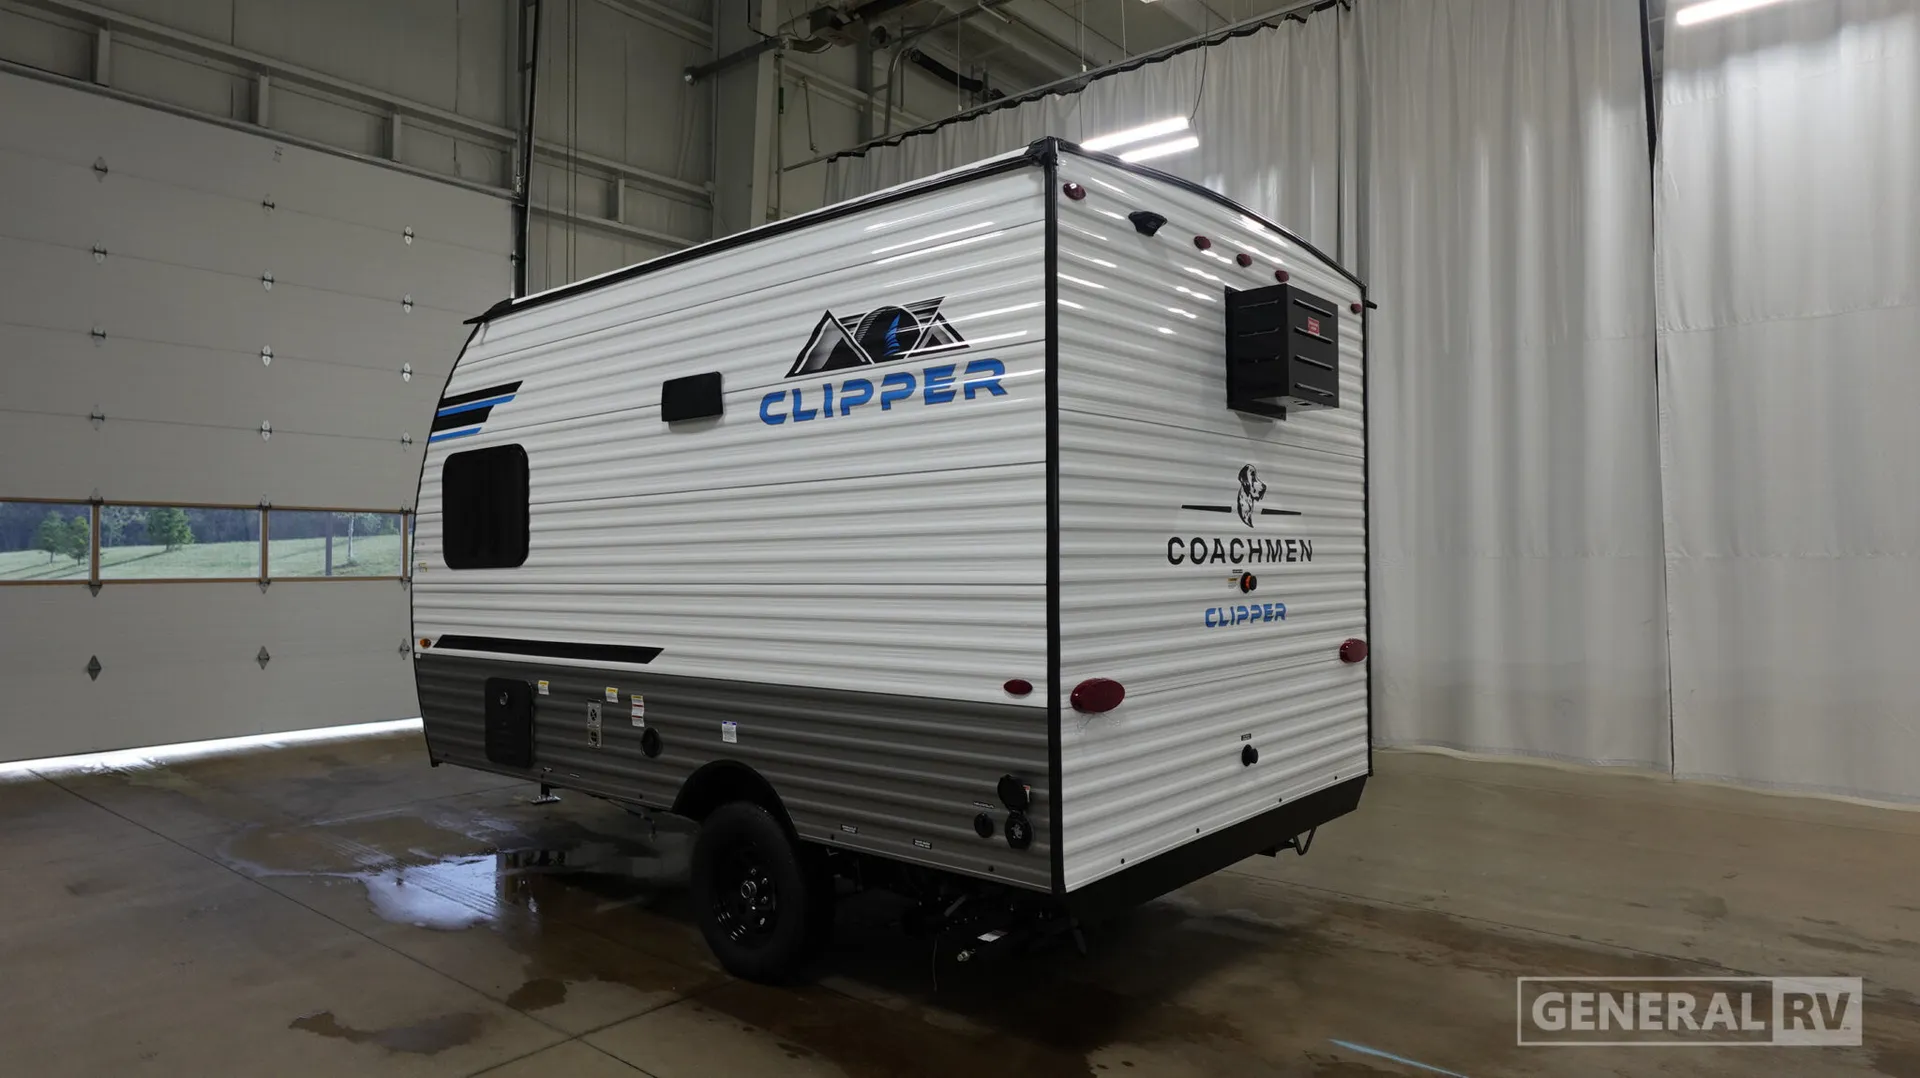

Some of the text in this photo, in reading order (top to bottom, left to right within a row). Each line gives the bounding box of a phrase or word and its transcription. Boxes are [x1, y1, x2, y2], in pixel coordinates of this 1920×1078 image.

[759, 357, 1008, 426] CLIPPER
[1167, 536, 1313, 565] COACHMEN
[1204, 602, 1287, 628] CLIPPER
